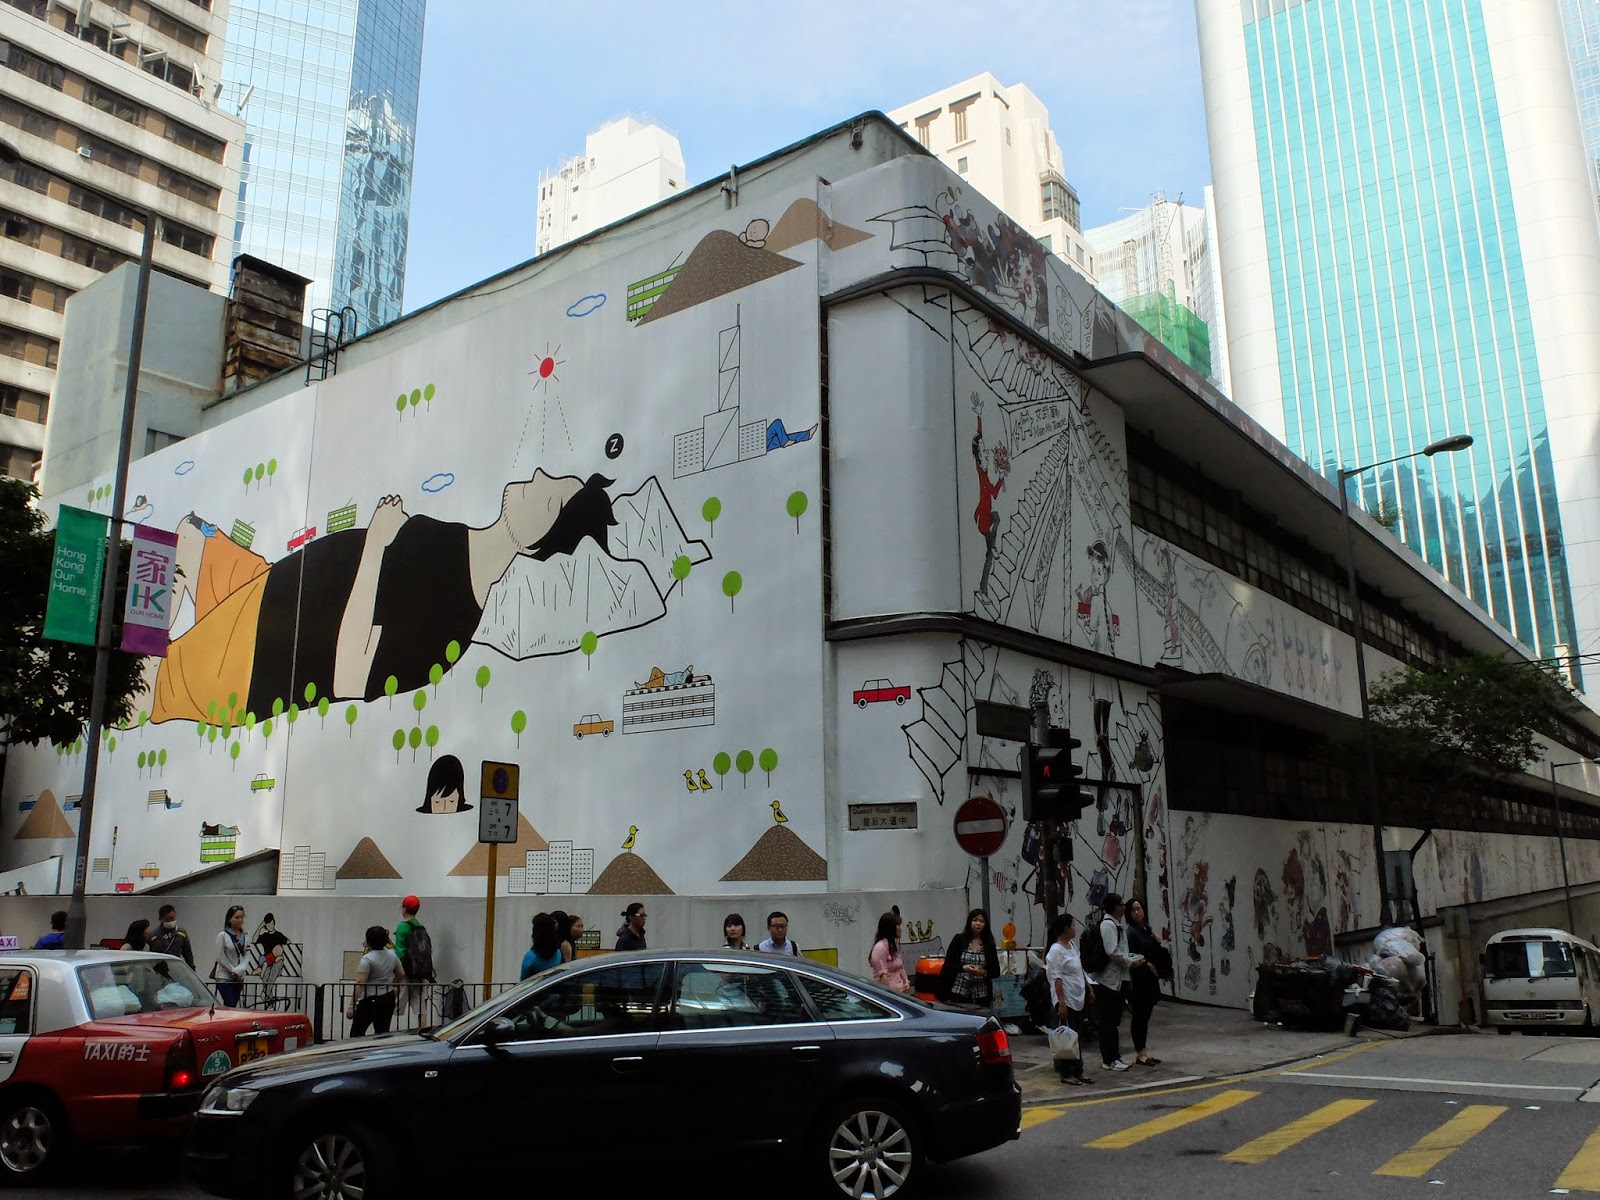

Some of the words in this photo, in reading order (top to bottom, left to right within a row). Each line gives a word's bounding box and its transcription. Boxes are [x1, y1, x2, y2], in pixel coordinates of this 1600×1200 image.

[57, 545, 87, 562] Hong
[55, 557, 85, 574] Kong
[136, 550, 170, 586] 家
[54, 568, 76, 581] Our
[52, 581, 87, 596] Home
[132, 583, 167, 613] HK
[130, 608, 145, 617] OUR
[146, 612, 165, 620] HOME
[505, 802, 511, 816] 7
[863, 815, 906, 826] 皇后大道中
[504, 825, 510, 839] 7
[84, 1042, 118, 1061] TAXI
[117, 1043, 151, 1062] 的士
[214, 1058, 221, 1066] 5
